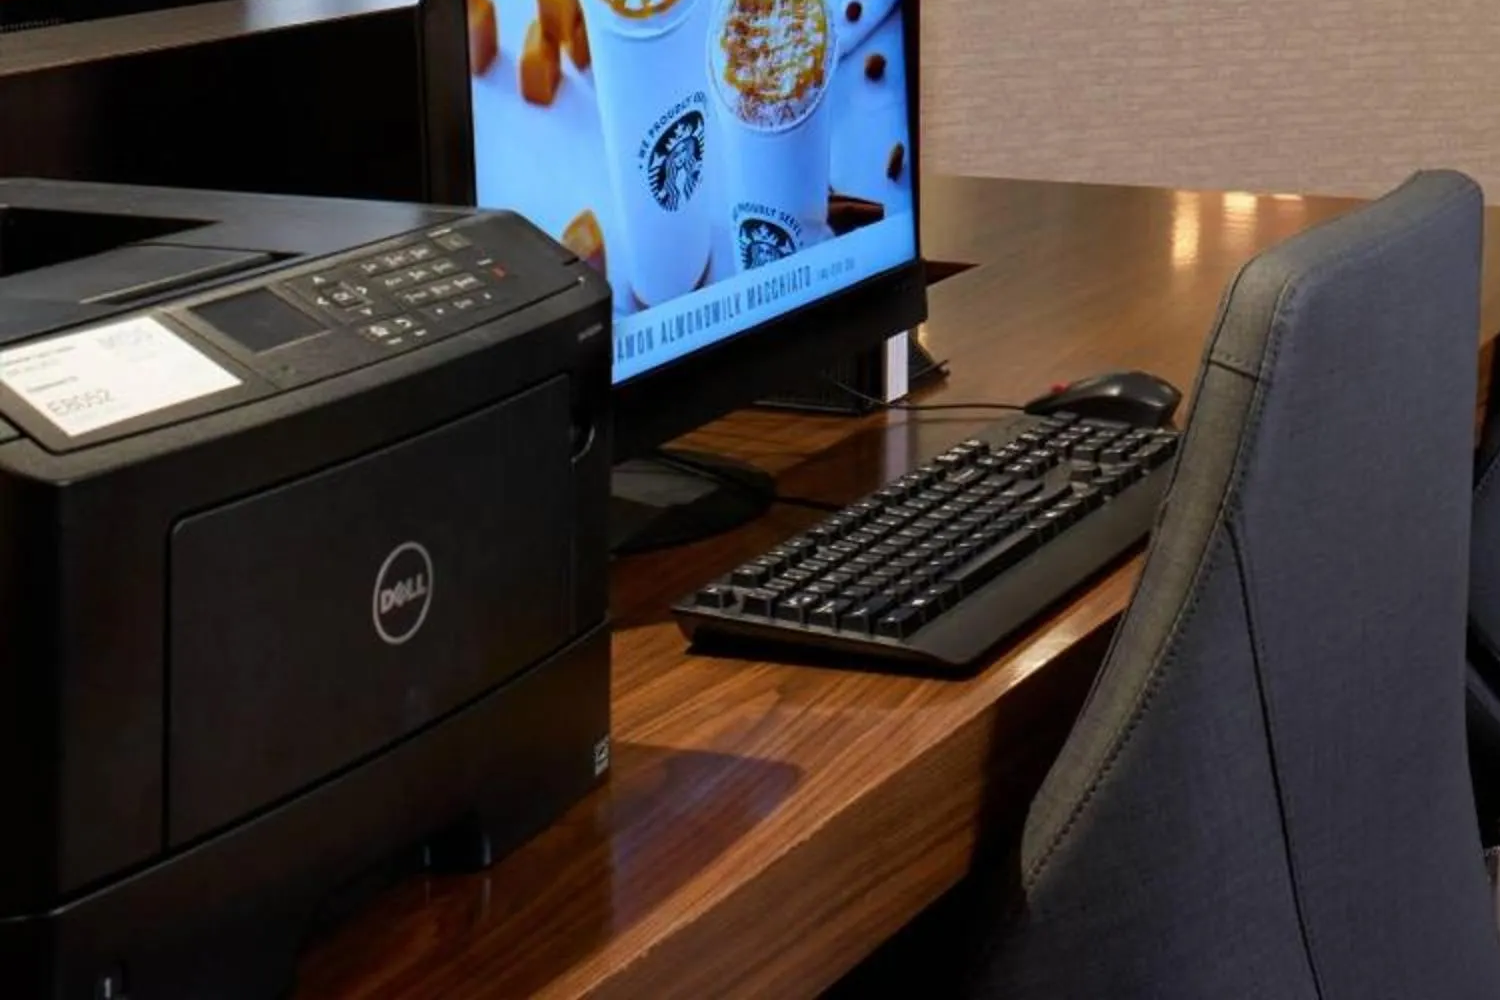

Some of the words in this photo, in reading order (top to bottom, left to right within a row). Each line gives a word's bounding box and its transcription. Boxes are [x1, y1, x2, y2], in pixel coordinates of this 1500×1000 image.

[661, 292, 741, 344] ALMONDMILK
[747, 264, 811, 310] MACCHIATO
[380, 573, 427, 614] DELL
